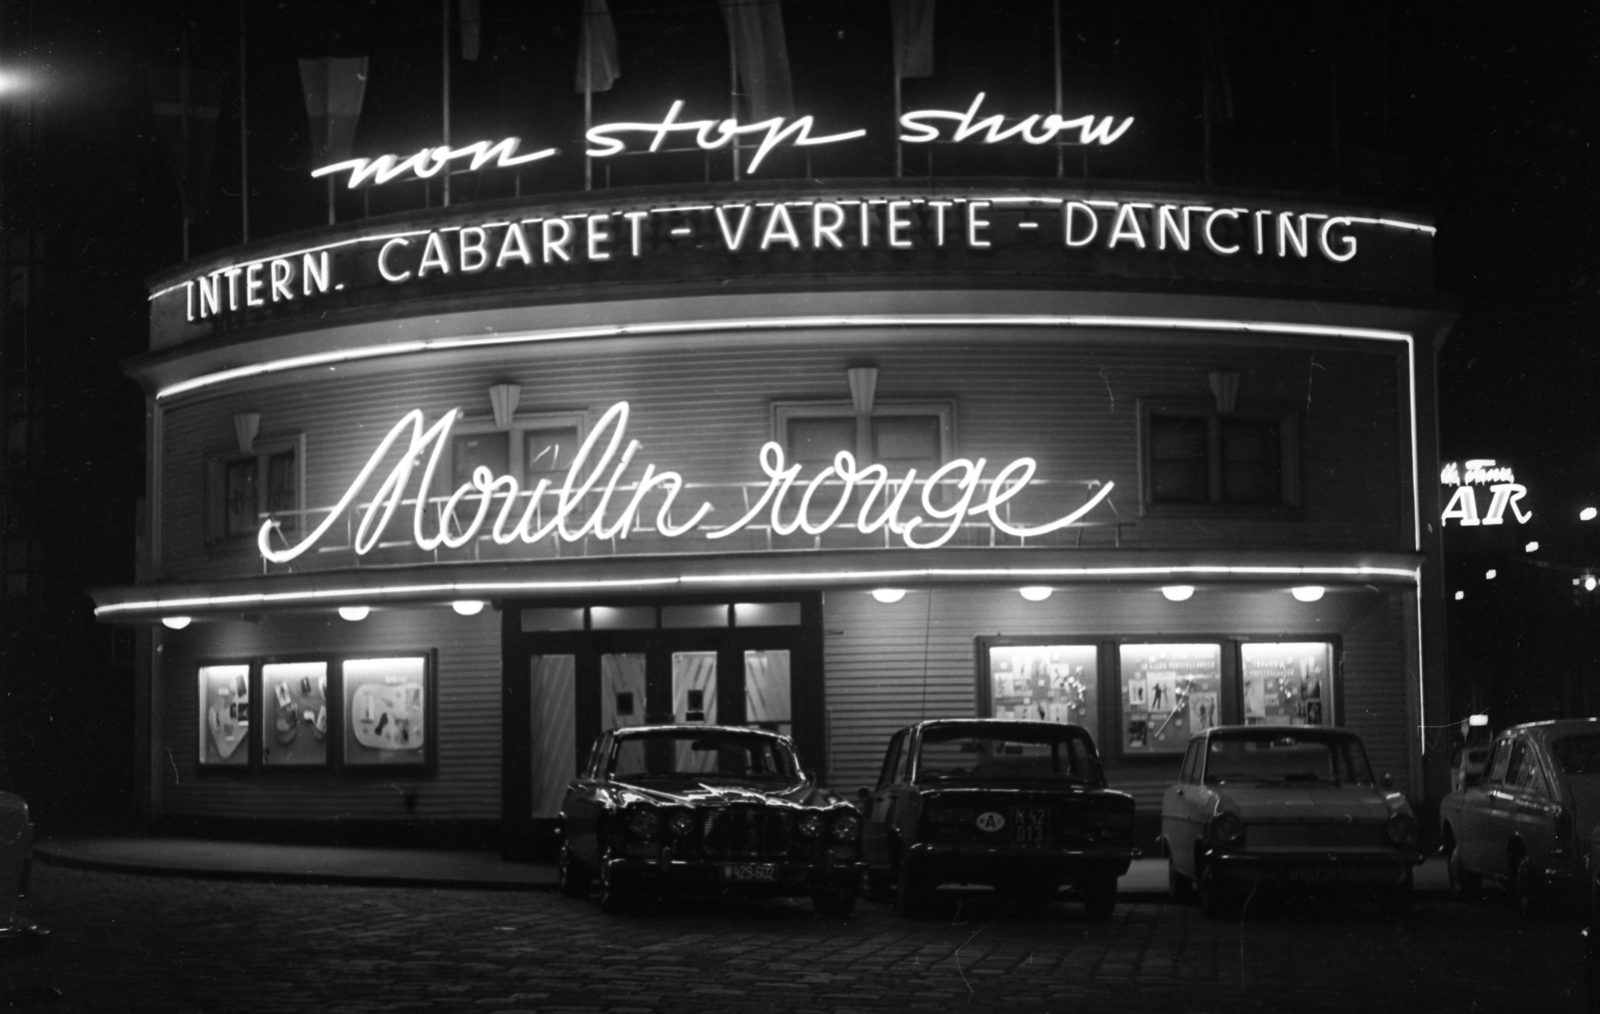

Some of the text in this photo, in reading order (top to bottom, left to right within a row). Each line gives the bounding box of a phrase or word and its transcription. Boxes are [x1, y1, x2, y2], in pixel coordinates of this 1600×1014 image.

[311, 91, 1135, 188] non stop show
[186, 250, 344, 321] INTERN.
[378, 211, 648, 282] CABARET
[715, 201, 992, 251] VARIETE
[1066, 202, 1357, 262] DANCING
[258, 401, 1115, 563] Moulin rouge
